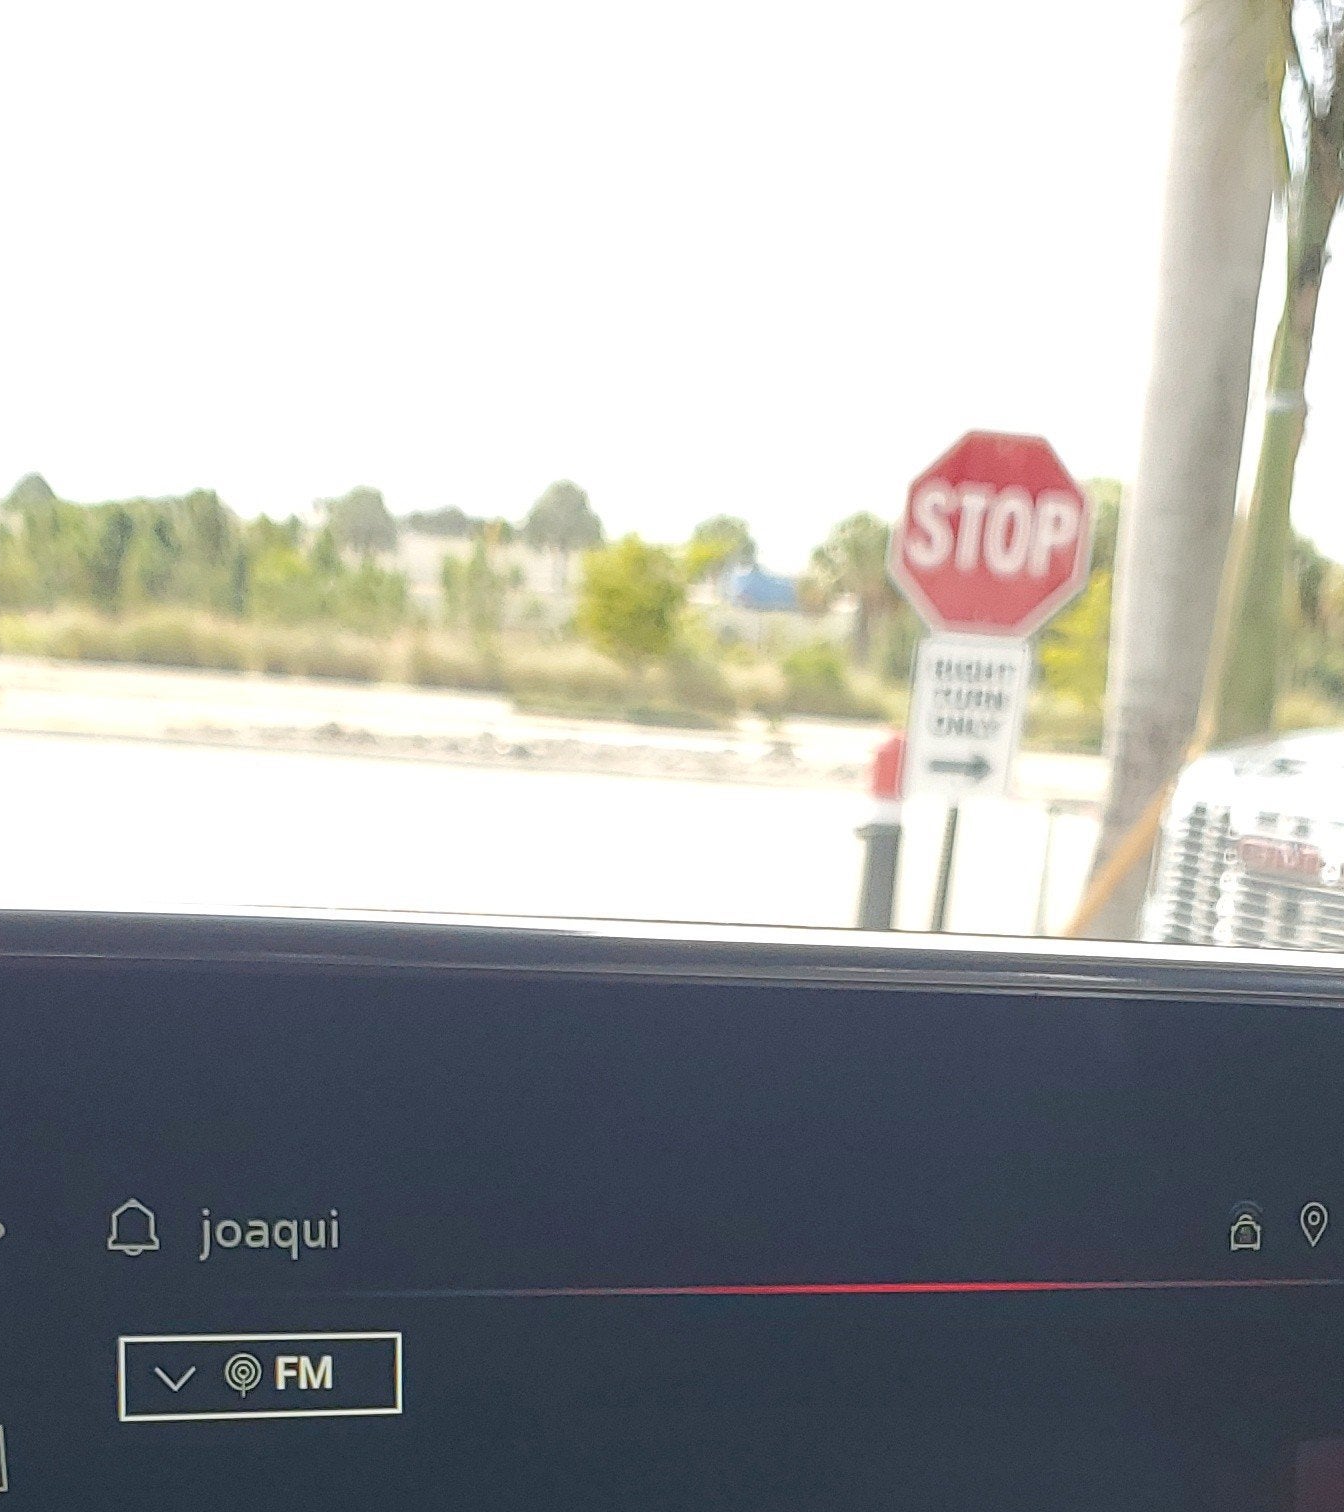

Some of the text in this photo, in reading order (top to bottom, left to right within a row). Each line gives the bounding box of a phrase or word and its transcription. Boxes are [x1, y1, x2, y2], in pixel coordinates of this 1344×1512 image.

[904, 478, 1080, 580] STOP
[933, 658, 1016, 683] RIGHT
[933, 686, 1009, 711] TURN
[930, 715, 1002, 739] ONLY
[199, 1207, 340, 1261] joaqui
[275, 1354, 334, 1391] FM
